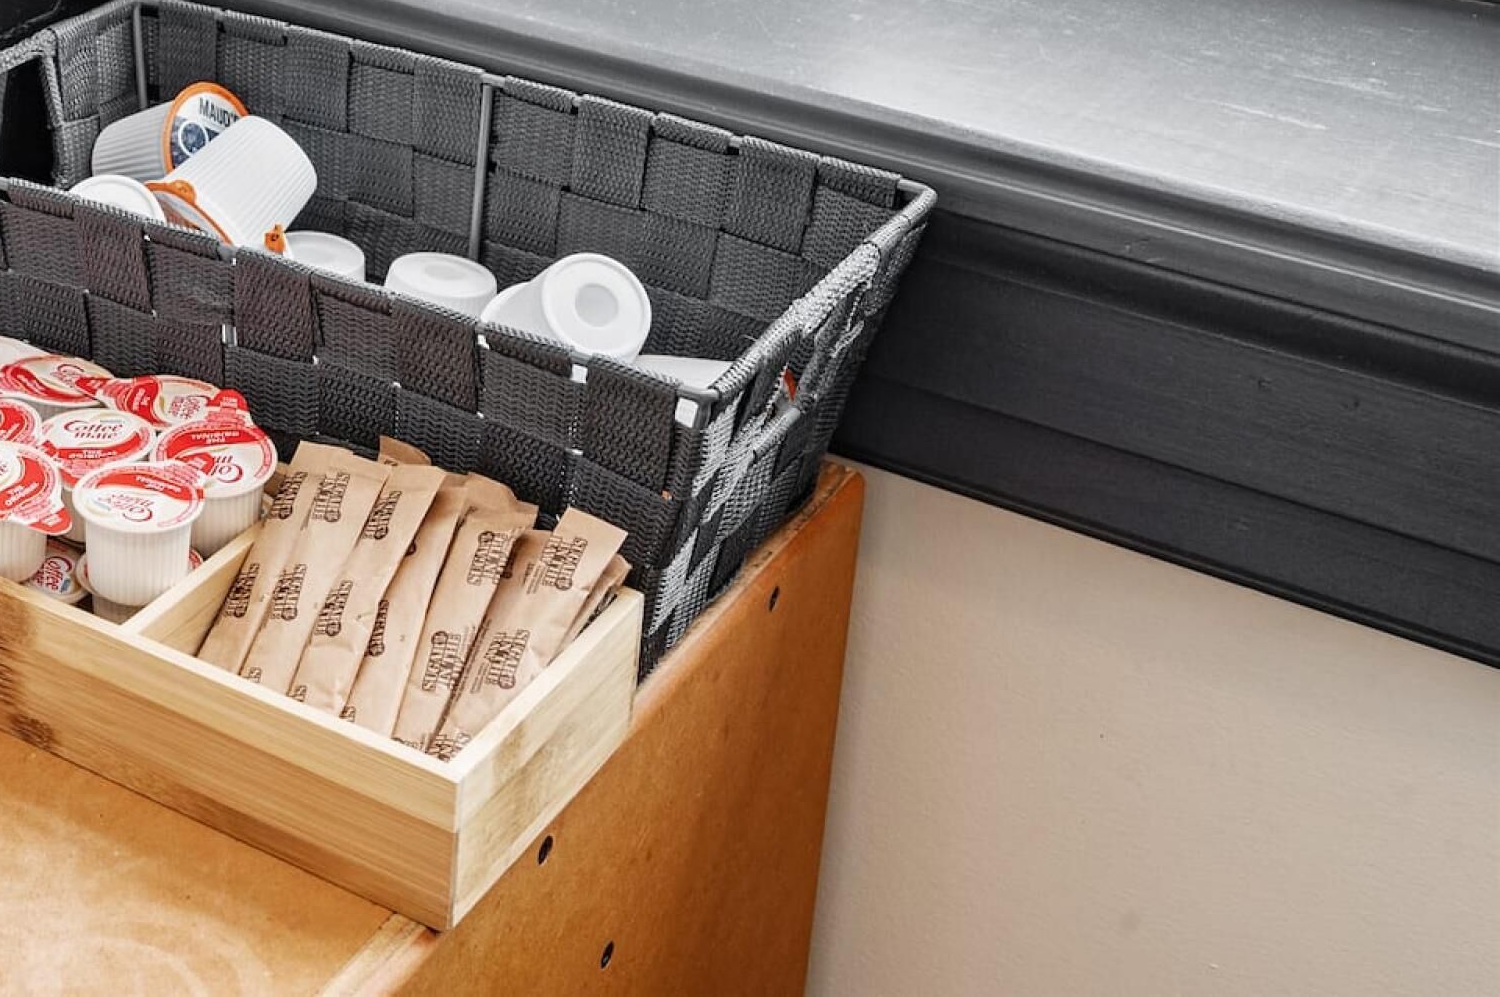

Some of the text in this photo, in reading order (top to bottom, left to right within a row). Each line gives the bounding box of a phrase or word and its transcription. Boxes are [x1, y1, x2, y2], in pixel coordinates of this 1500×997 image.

[63, 419, 124, 433] Coffee
[422, 630, 448, 691] SUGAR
[499, 629, 531, 690] SUGAR
